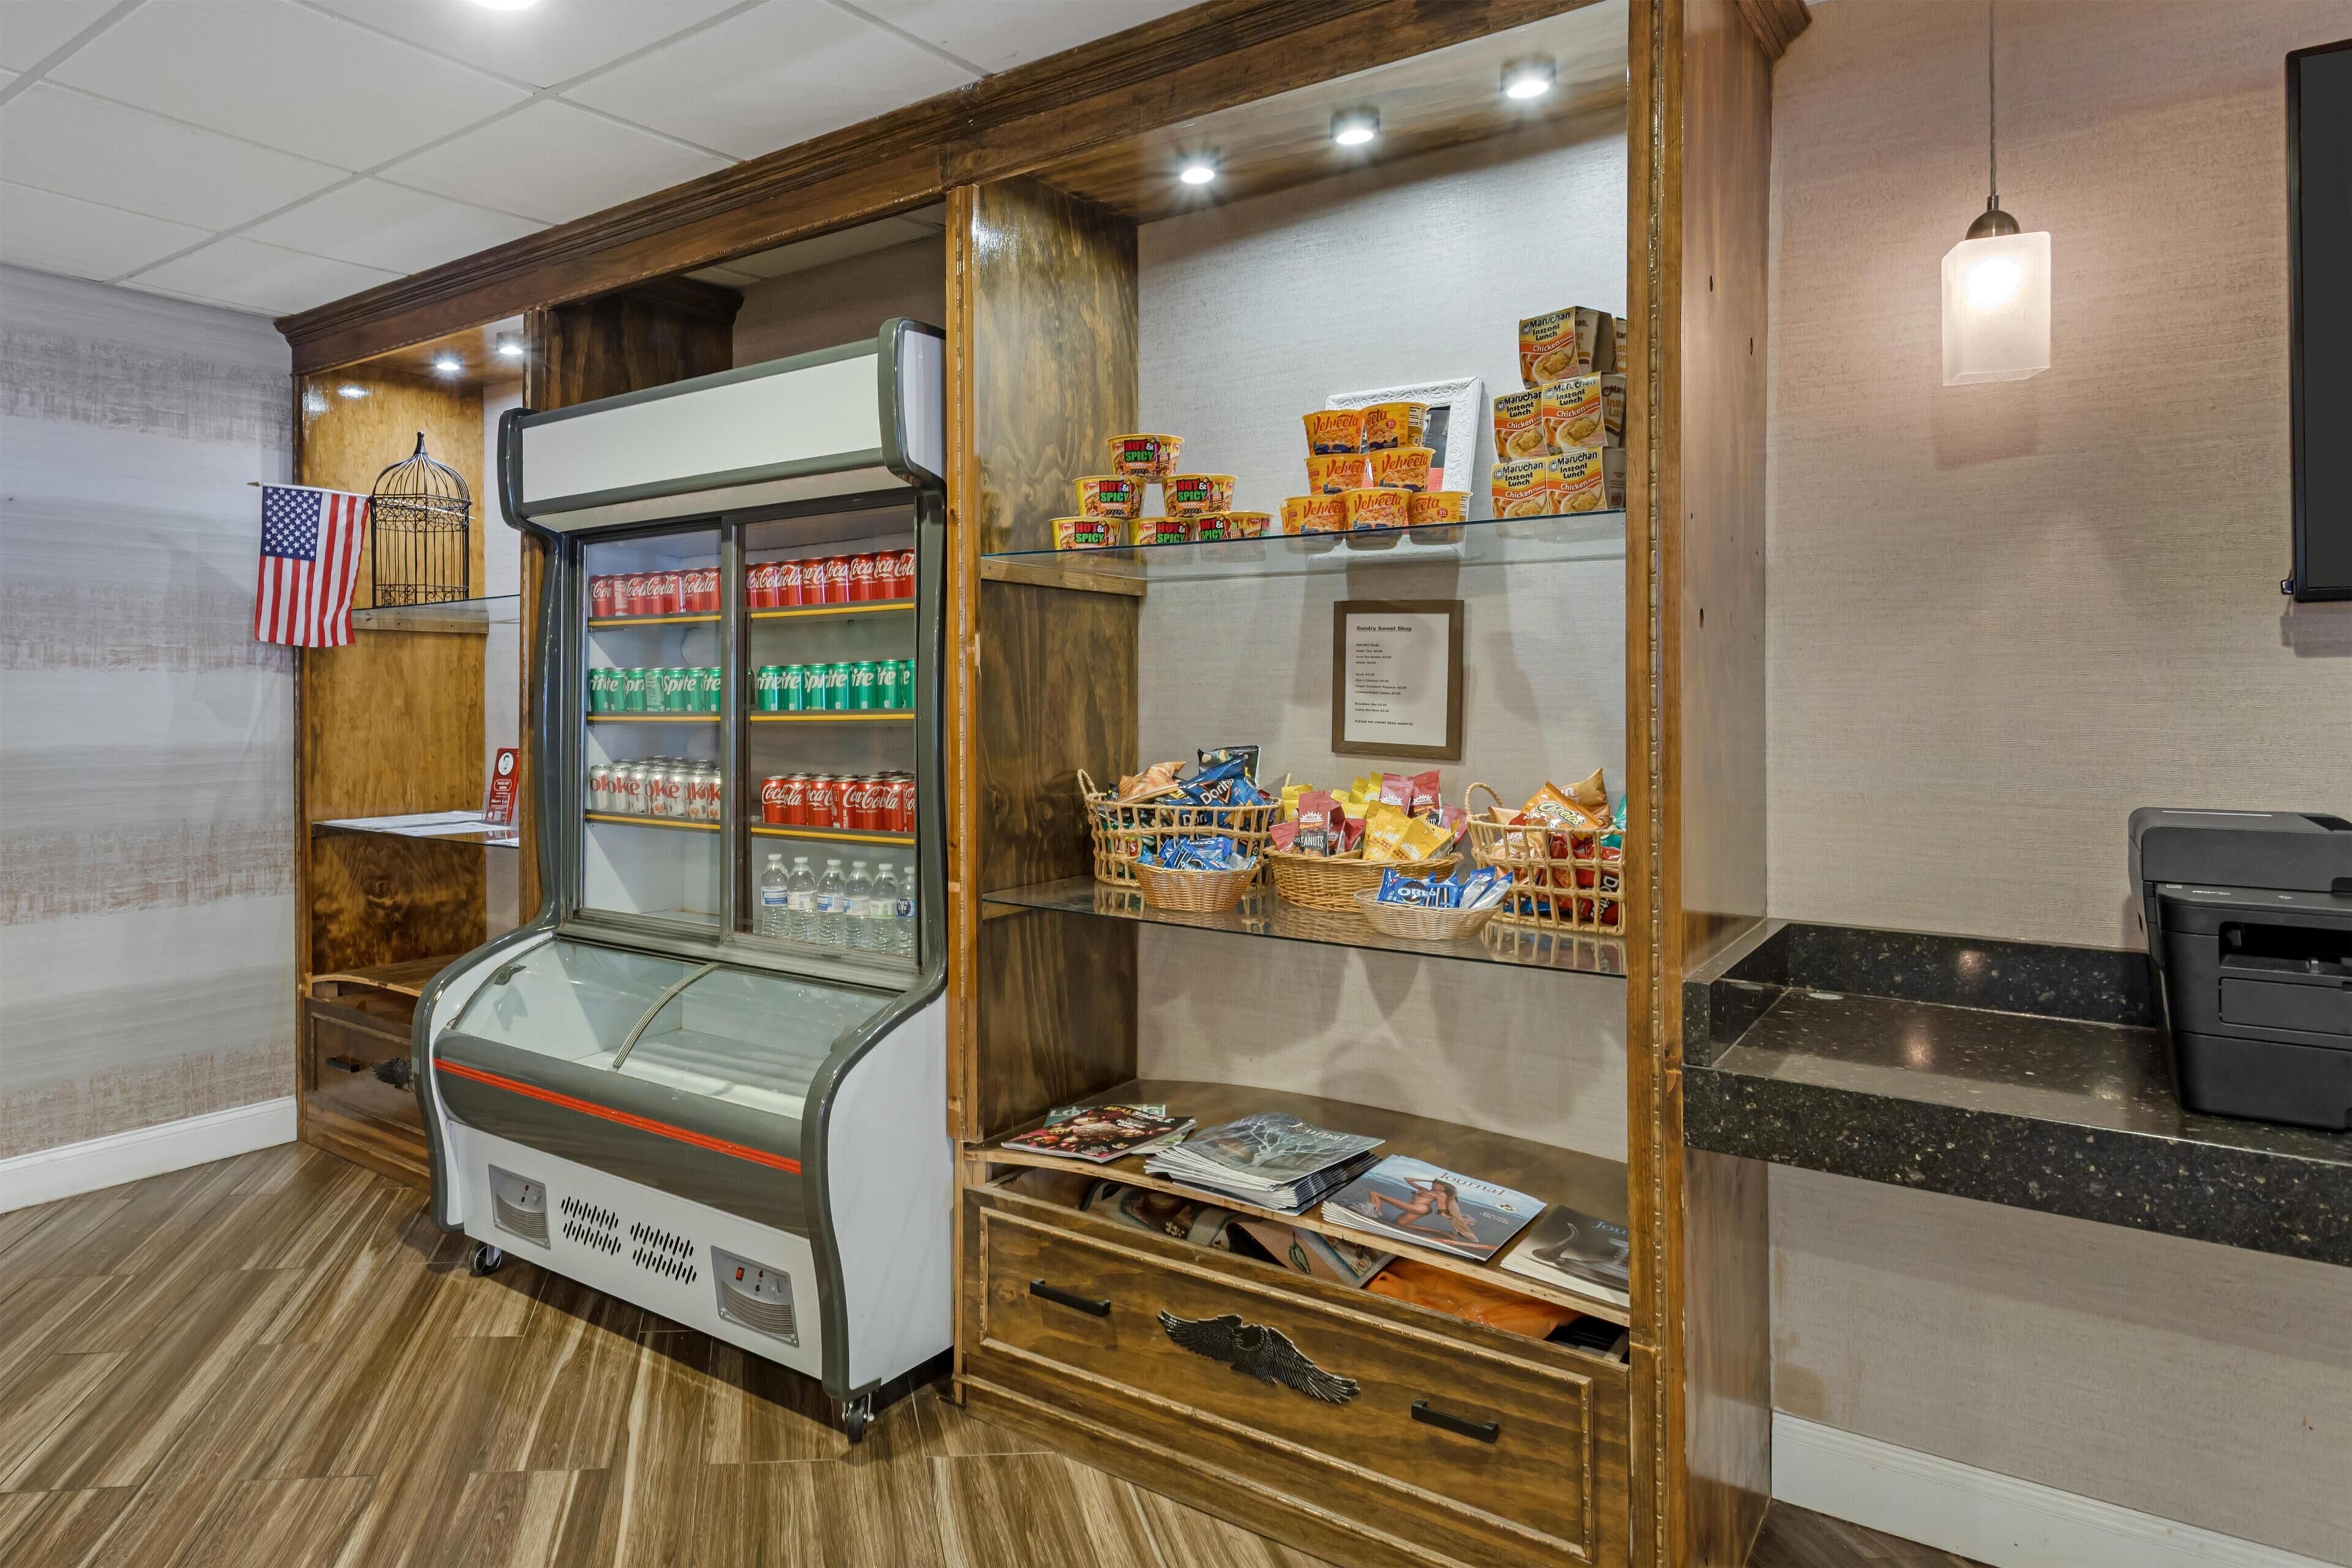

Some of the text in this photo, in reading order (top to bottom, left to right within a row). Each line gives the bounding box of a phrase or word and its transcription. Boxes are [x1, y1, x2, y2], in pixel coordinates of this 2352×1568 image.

[1531, 311, 1571, 329] Maruchan
[1532, 323, 1560, 336] Instant
[1536, 331, 1558, 341] Lunch
[1532, 339, 1560, 352] Chicken
[1556, 388, 1585, 401] Instant
[1559, 396, 1583, 406] Lunch
[1507, 401, 1534, 413] Instant
[1556, 406, 1586, 418] Chicken
[1509, 408, 1531, 418] Lunch
[1313, 413, 1359, 435] Velveeta
[1506, 418, 1534, 429] Chicken
[1125, 440, 1154, 452] HOT &
[1125, 451, 1154, 462] SPICY
[1557, 451, 1597, 466] Maruchan
[1382, 453, 1428, 473] Velveeta
[1502, 462, 1544, 474] Maruchan
[1560, 462, 1588, 473] Instant
[1505, 472, 1533, 482] Instant
[1563, 469, 1585, 480] Lunch
[1100, 481, 1123, 492] HOT
[1177, 480, 1199, 491] HOT
[1508, 478, 1530, 488] Lunch
[1560, 480, 1588, 491] Chicken
[1100, 492, 1129, 502] SPICY
[1178, 491, 1207, 501] SPICY
[1505, 489, 1533, 499] Chicken
[1354, 492, 1402, 513] Velveeta
[1076, 522, 1098, 533] HOT
[1157, 522, 1180, 533] HOT
[1200, 519, 1216, 530] HOT
[1076, 533, 1104, 543] SPICY
[1157, 533, 1185, 543] SPICY
[1200, 528, 1224, 540] SPICY
[1537, 802, 1585, 825] Cheetos
[1300, 835, 1324, 848] EANUTS
[1397, 888, 1436, 897] OREO
[1103, 1106, 1132, 1116] REAL
[1131, 1110, 1175, 1123] SIMPLE
[1287, 1121, 1349, 1141] Journal
[1439, 1172, 1508, 1196] Journal
